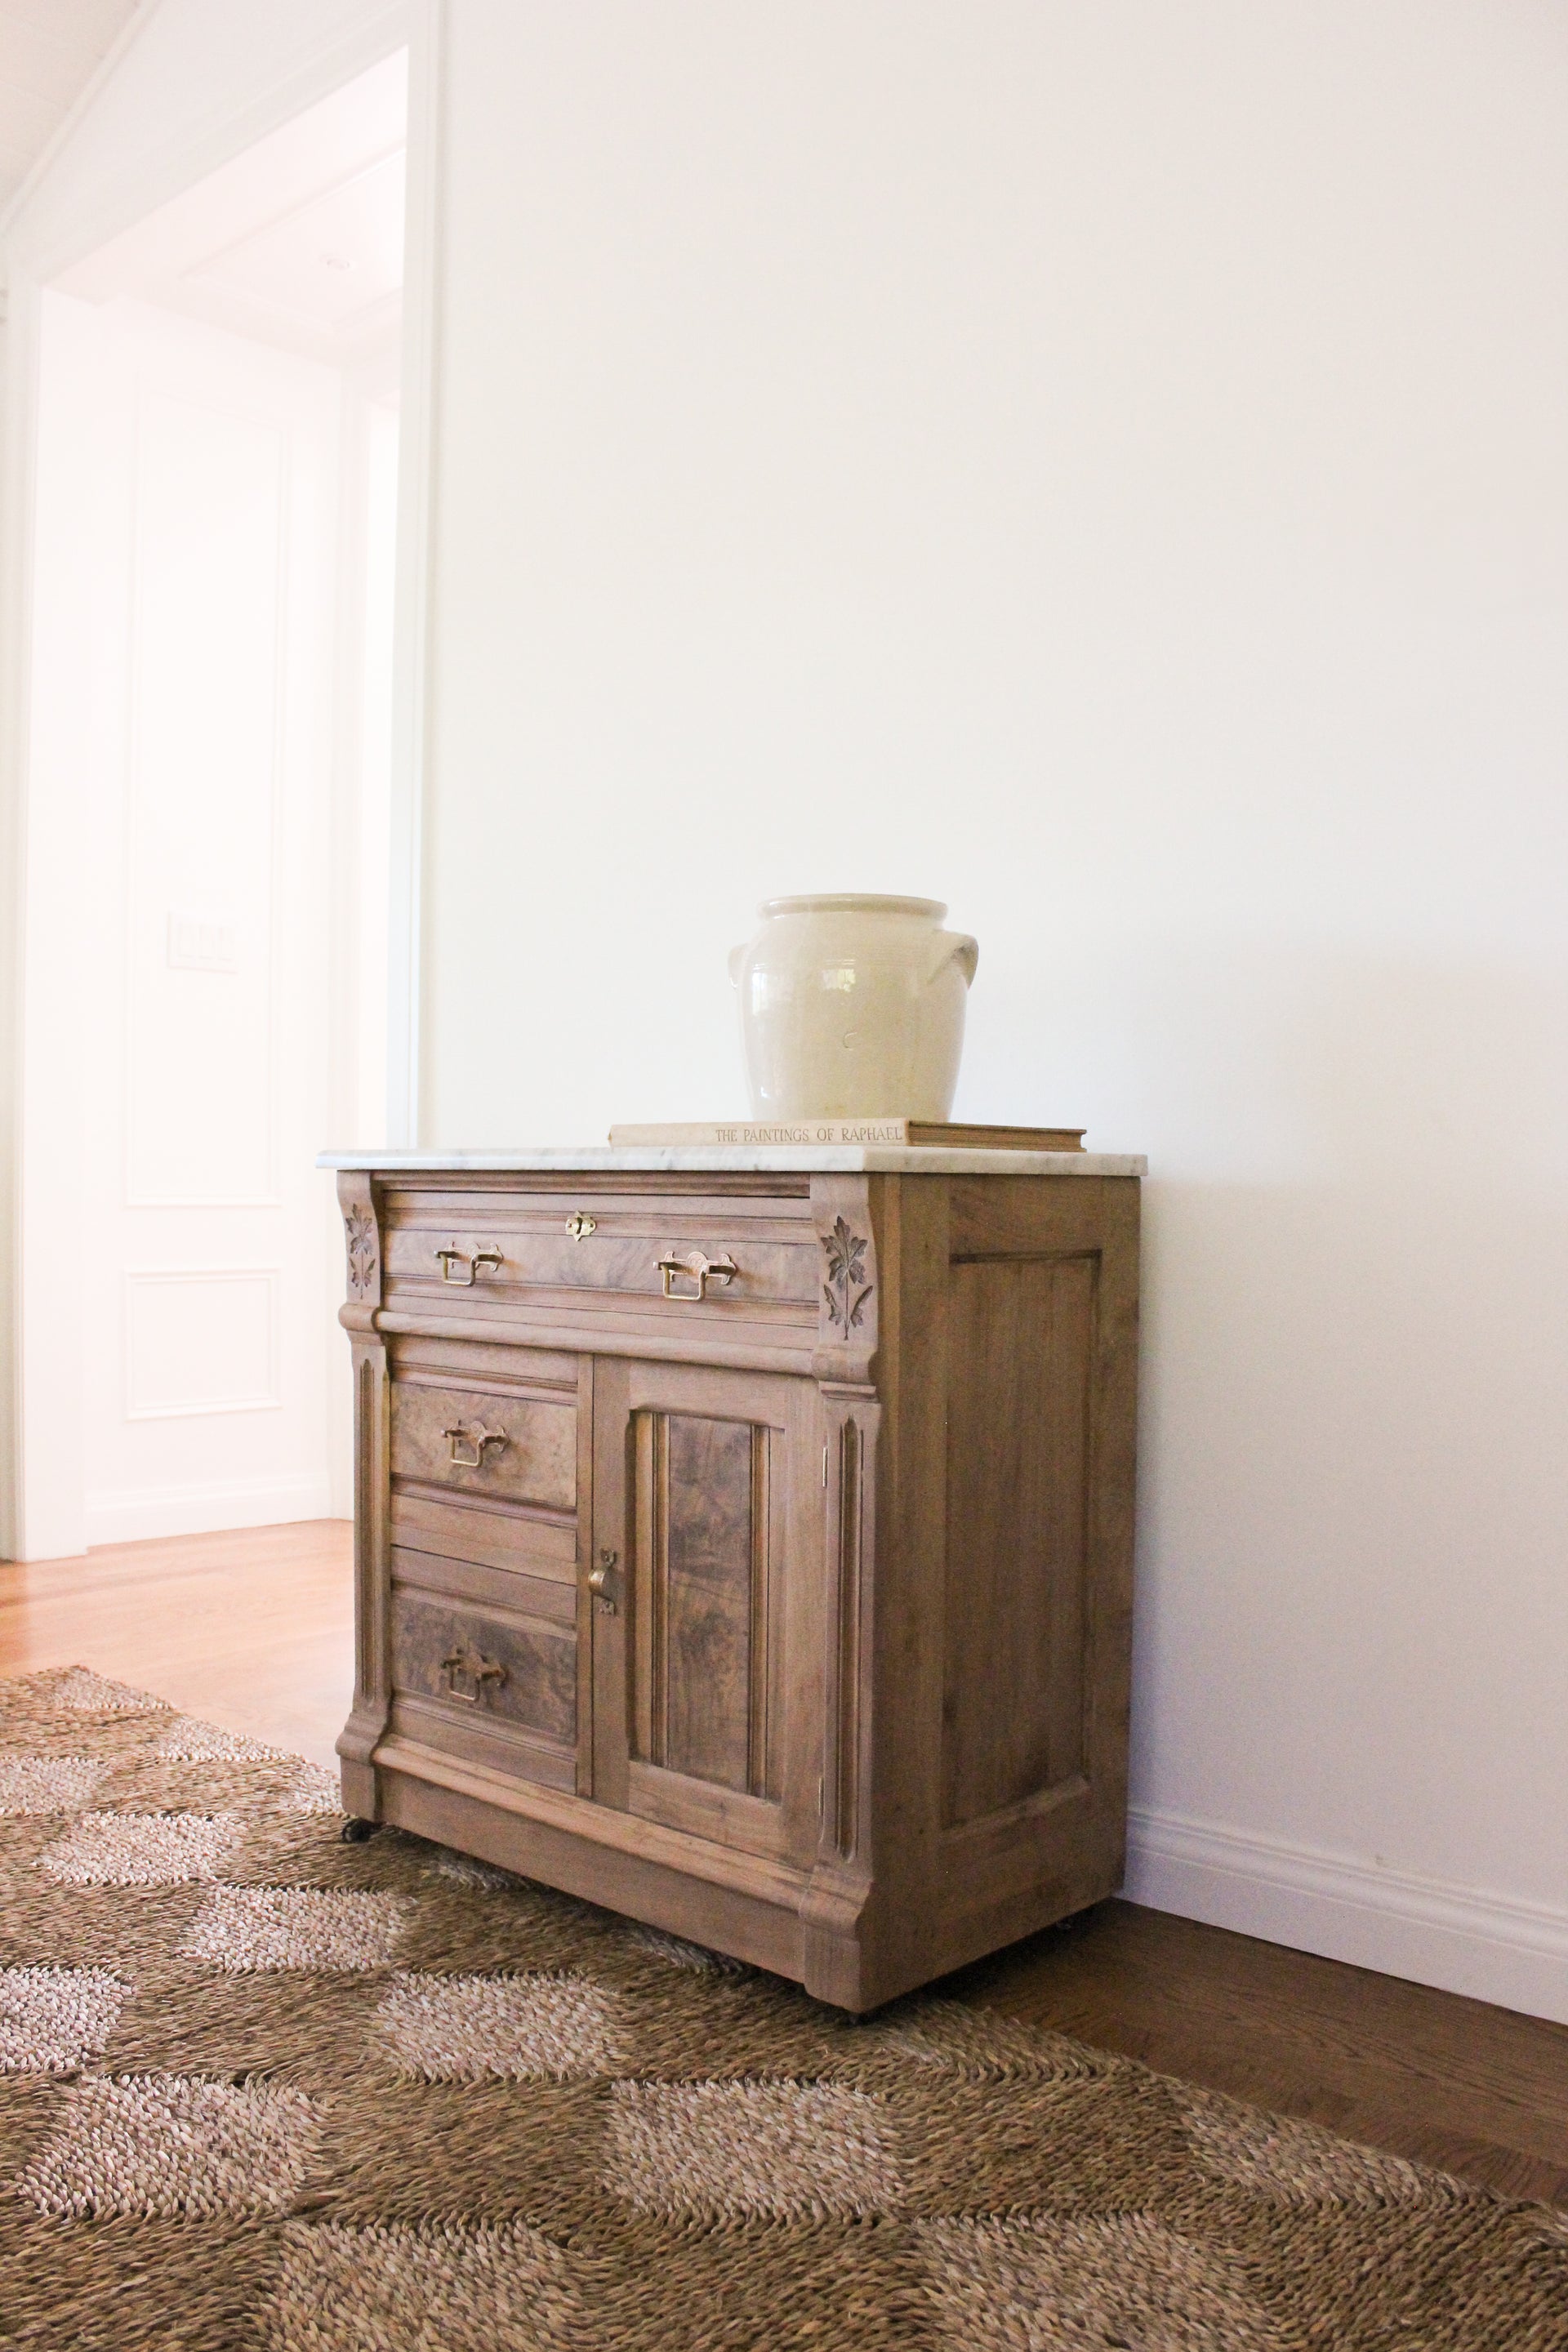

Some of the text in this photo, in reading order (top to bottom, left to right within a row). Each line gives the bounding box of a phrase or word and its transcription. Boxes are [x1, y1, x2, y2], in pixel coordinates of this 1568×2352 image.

[715, 1126, 902, 1143] THE PAINTINGS OF RAPHAEL
